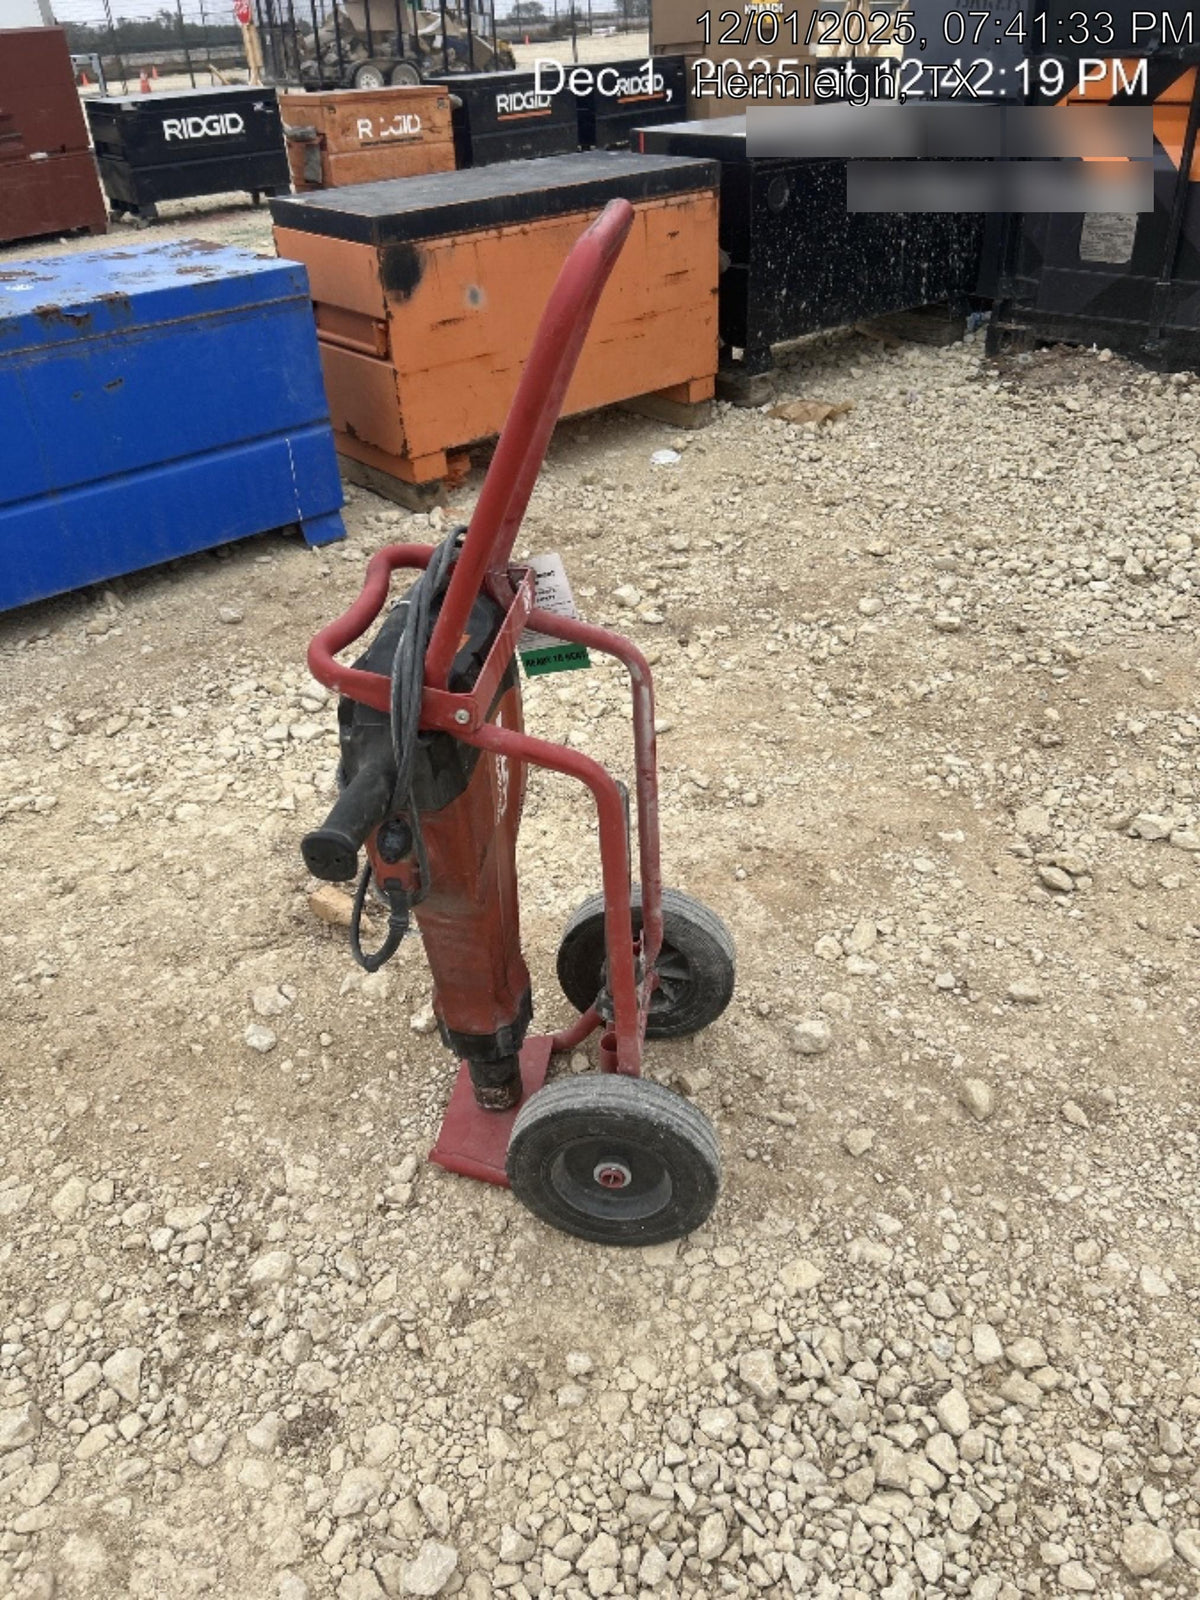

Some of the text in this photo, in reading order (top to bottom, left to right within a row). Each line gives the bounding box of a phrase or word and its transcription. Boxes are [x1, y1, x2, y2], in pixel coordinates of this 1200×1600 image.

[616, 74, 664, 97] RIDGD
[496, 91, 552, 114] RIDGID
[162, 113, 246, 141] RIDGID
[357, 113, 422, 139] RGID
